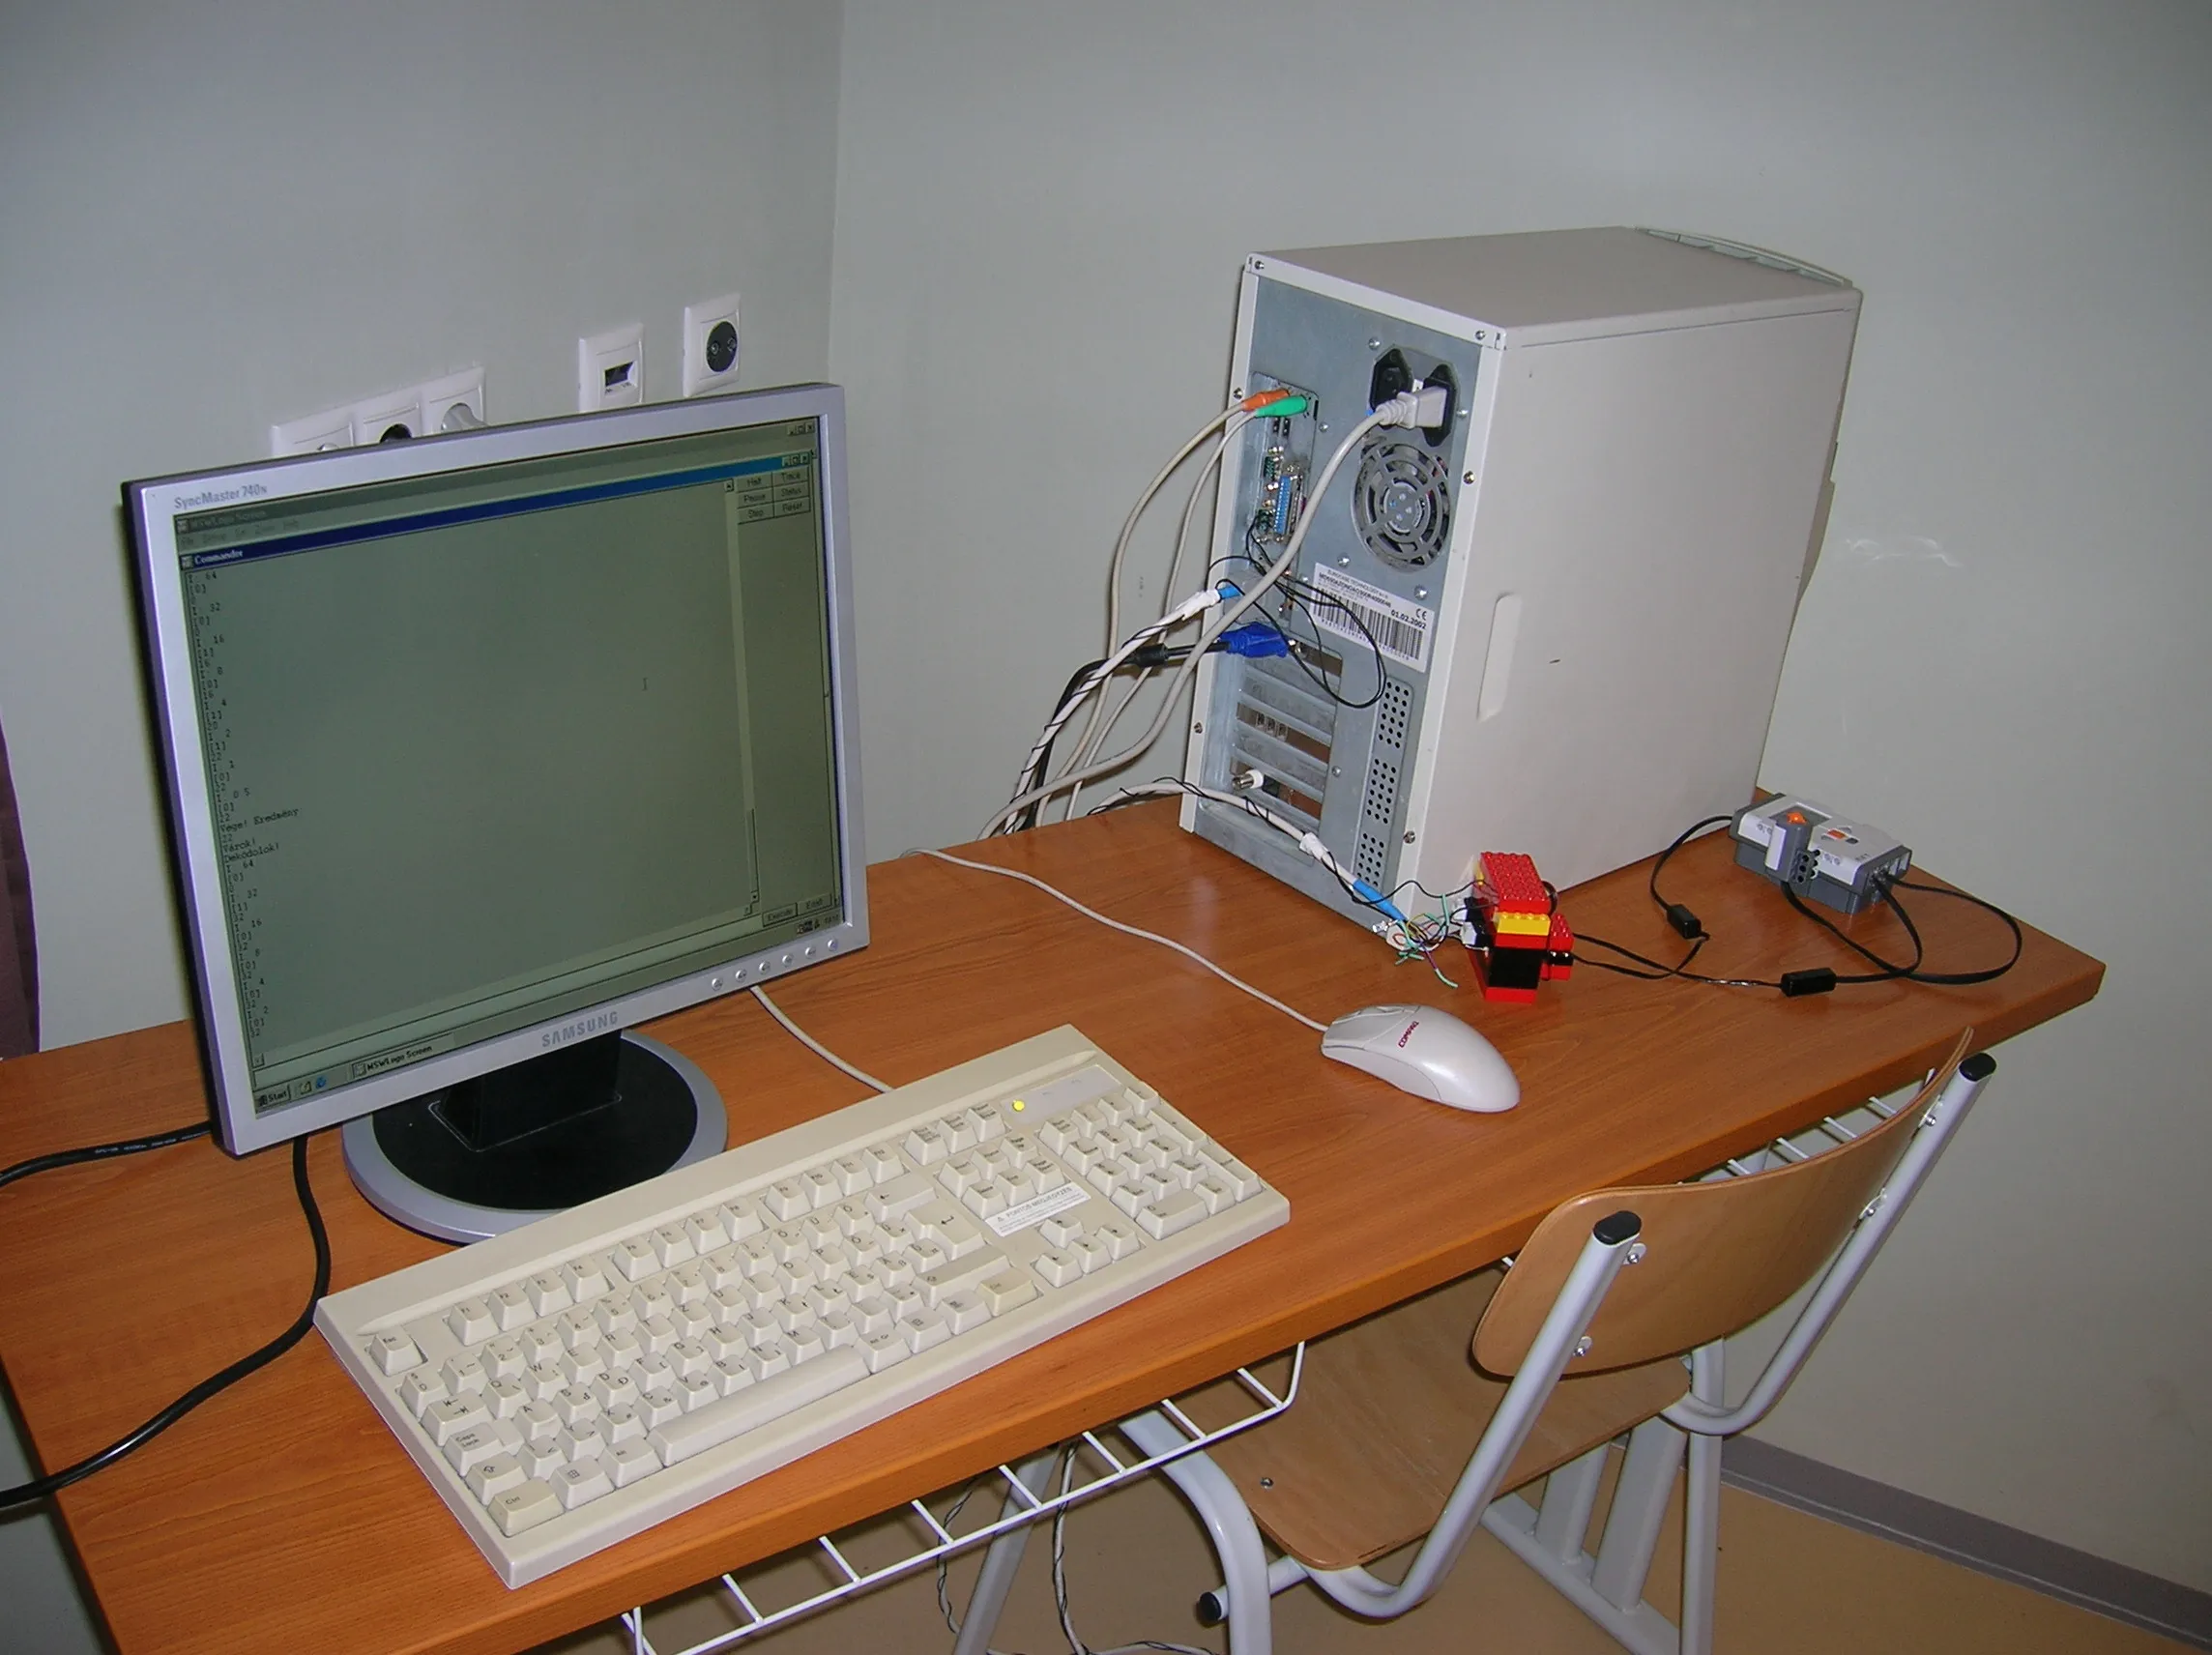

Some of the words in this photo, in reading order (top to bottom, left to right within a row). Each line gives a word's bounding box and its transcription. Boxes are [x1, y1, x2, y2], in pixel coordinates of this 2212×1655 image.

[174, 487, 241, 509] SyncMaster
[541, 1011, 619, 1048] SAMSUNG
[1398, 1020, 1420, 1048] COMPAQ
